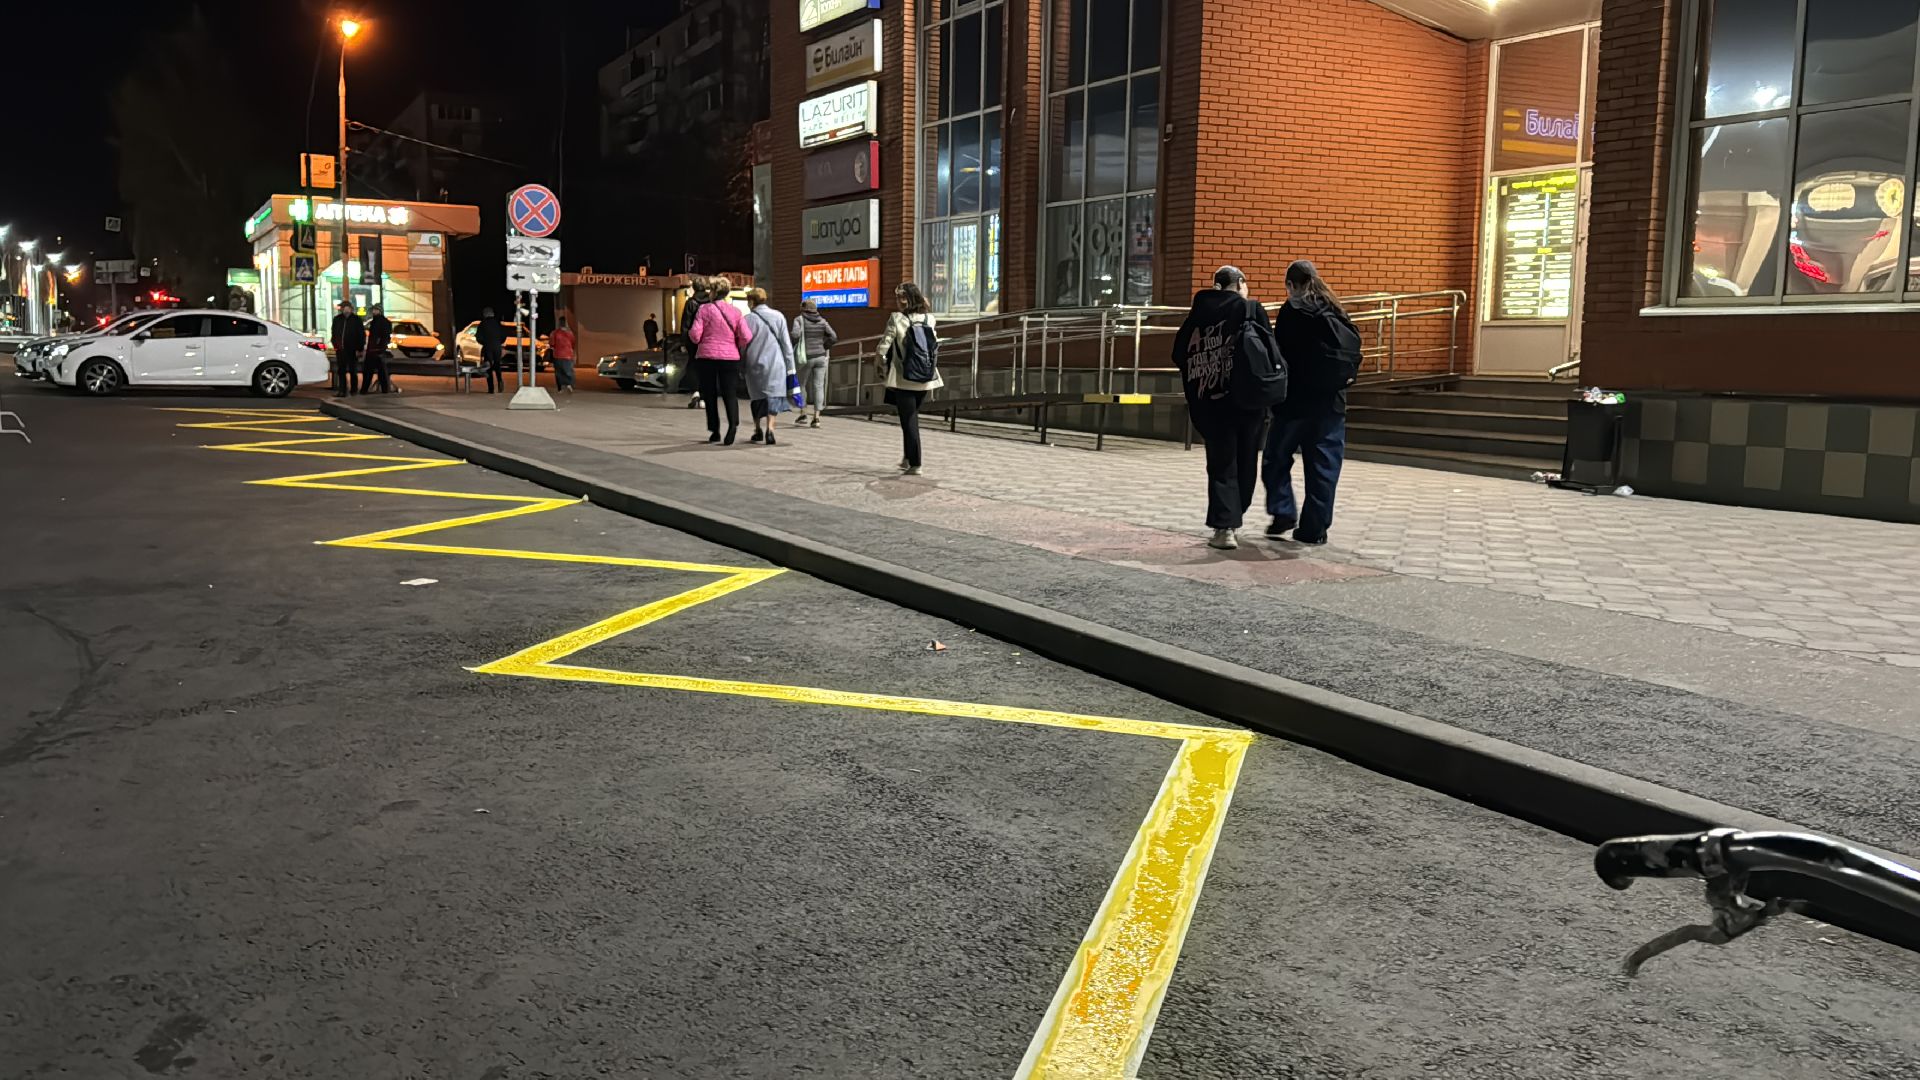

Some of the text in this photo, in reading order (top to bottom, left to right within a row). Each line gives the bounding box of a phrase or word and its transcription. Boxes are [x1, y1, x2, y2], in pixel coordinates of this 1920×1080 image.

[802, 89, 867, 122] LAZURIT
[578, 275, 656, 286] МОРОЖЕНОЕ
[812, 266, 867, 284] ЧЕТЫРЕ ЛАПЫ
